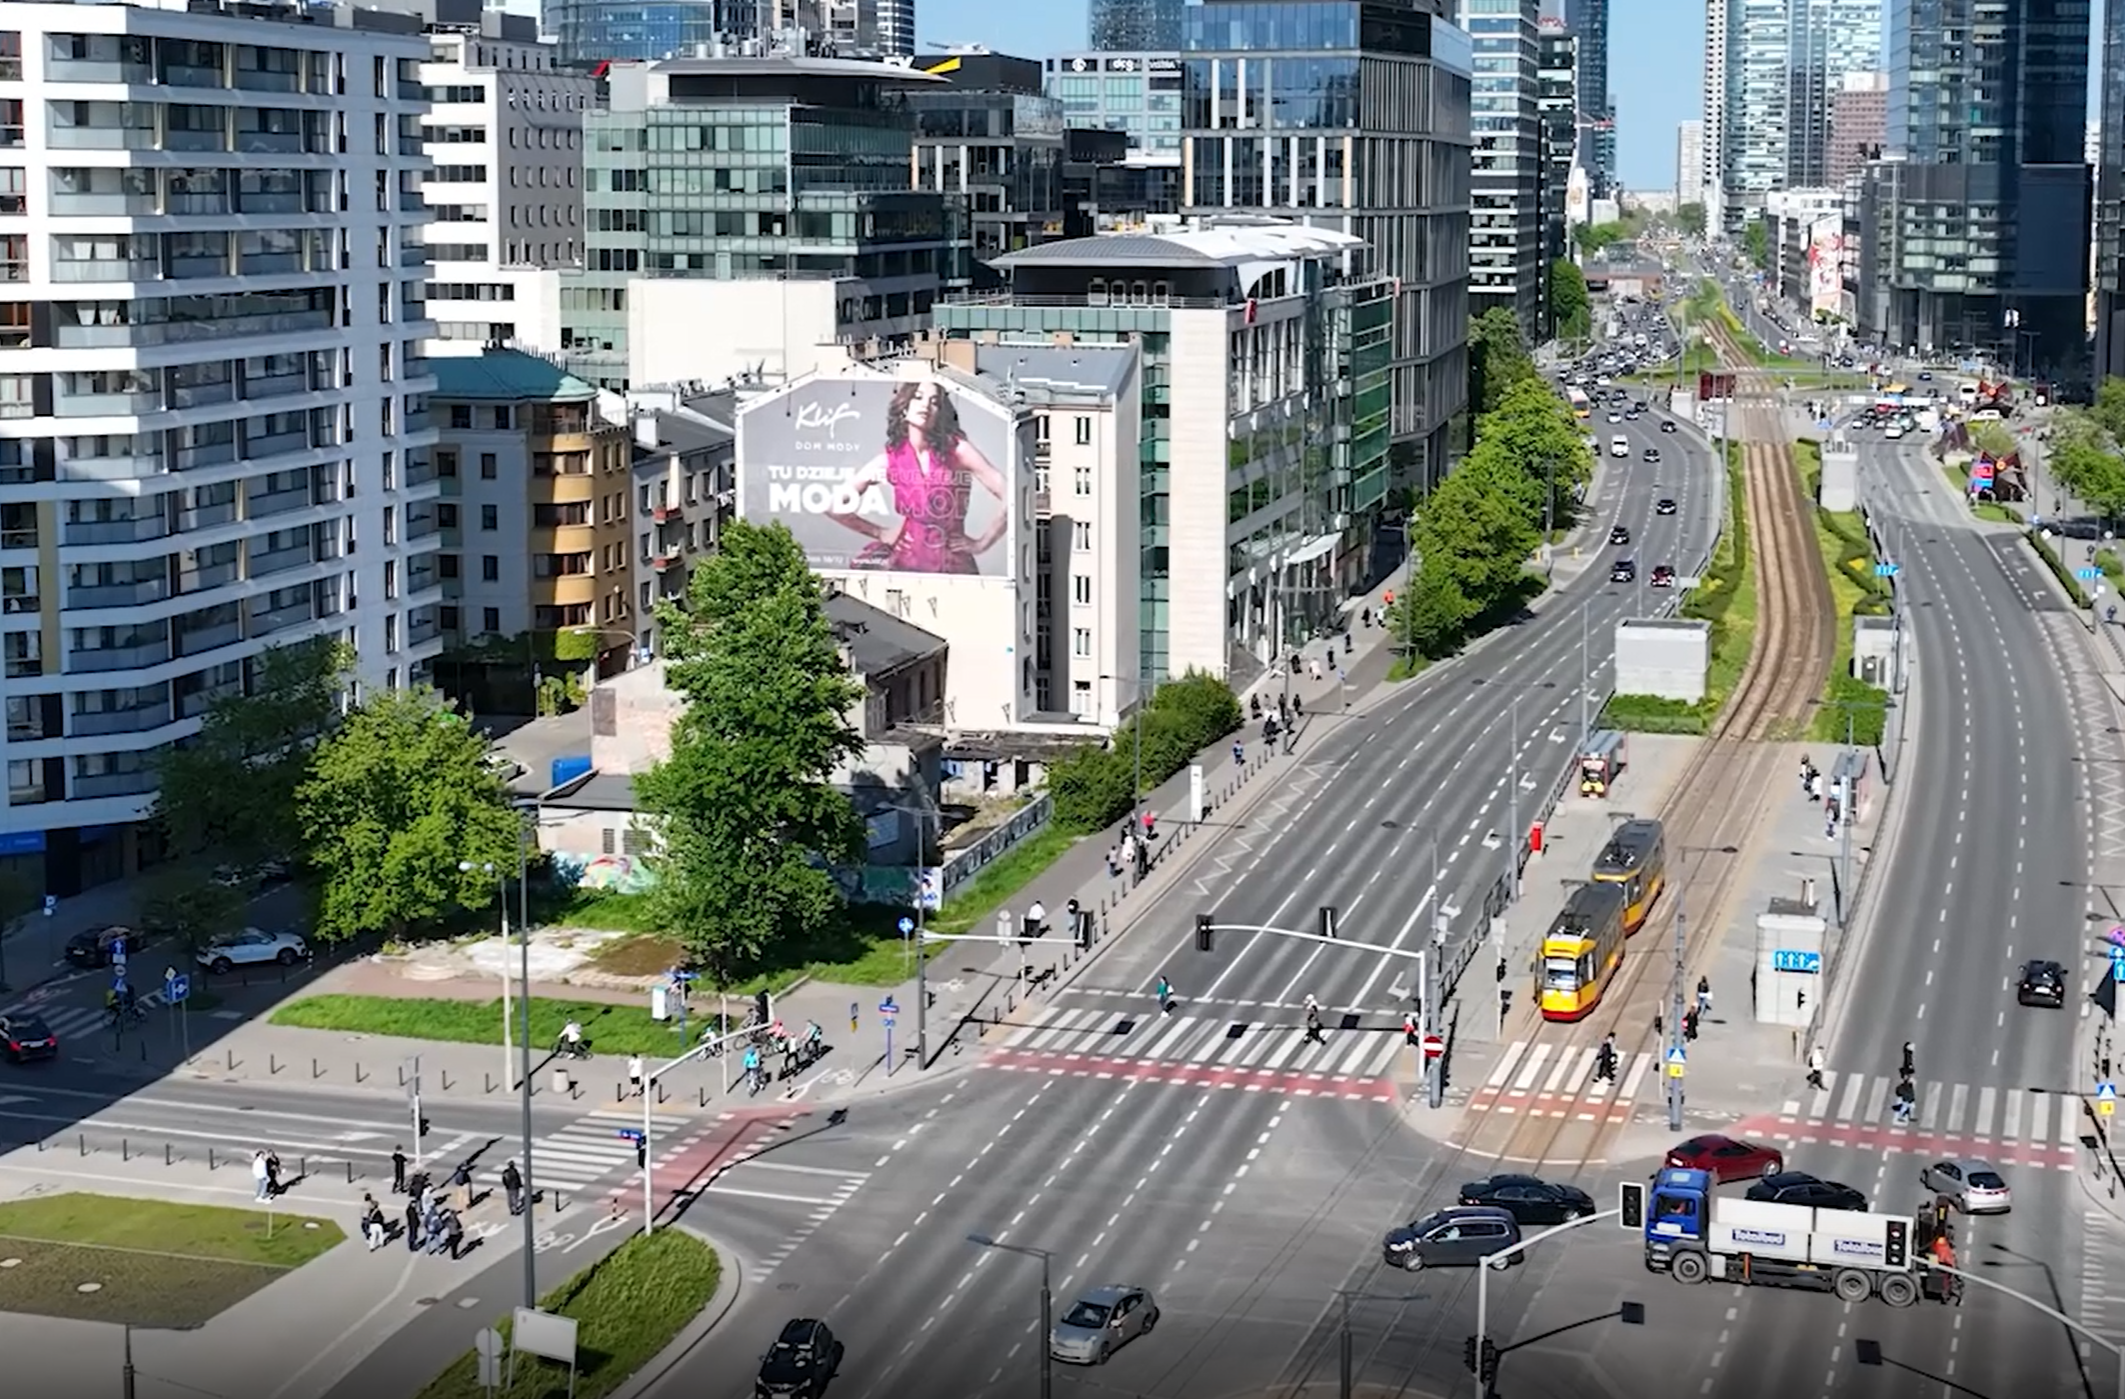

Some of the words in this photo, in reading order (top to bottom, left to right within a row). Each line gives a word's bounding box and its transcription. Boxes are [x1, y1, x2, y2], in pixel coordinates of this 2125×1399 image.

[796, 402, 860, 439] Klif
[795, 441, 821, 451] DOM
[768, 465, 792, 480] TU
[769, 482, 890, 516] MODA
